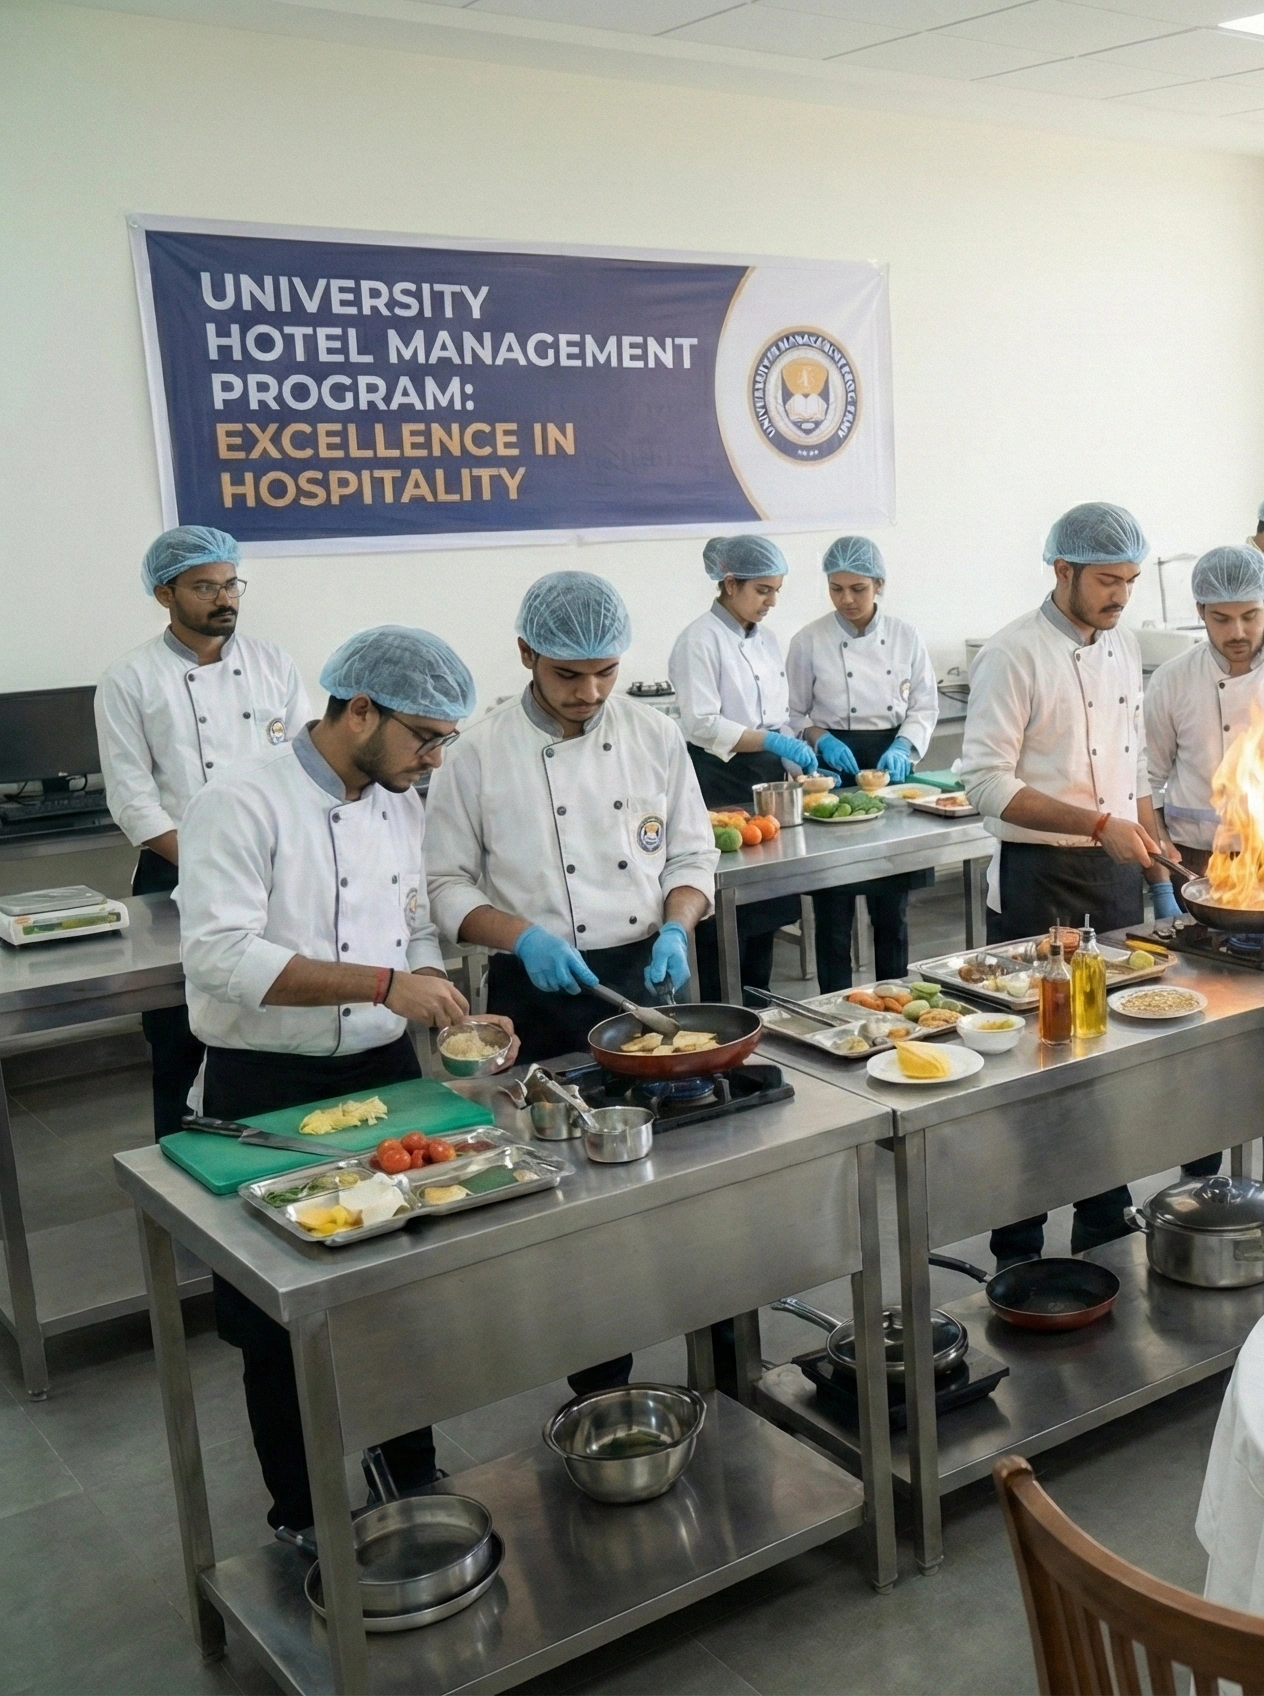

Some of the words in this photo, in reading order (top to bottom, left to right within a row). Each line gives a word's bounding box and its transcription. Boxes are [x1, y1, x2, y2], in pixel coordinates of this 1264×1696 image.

[200, 271, 490, 319] UNIVERSITY
[205, 323, 374, 363] HOTEL
[387, 329, 699, 369] MANAGEMENT
[211, 373, 475, 411] PROGRAM:
[216, 423, 519, 459] EXCELLENCE
[534, 423, 576, 455] IN
[220, 467, 526, 508] HOSPITALITY
